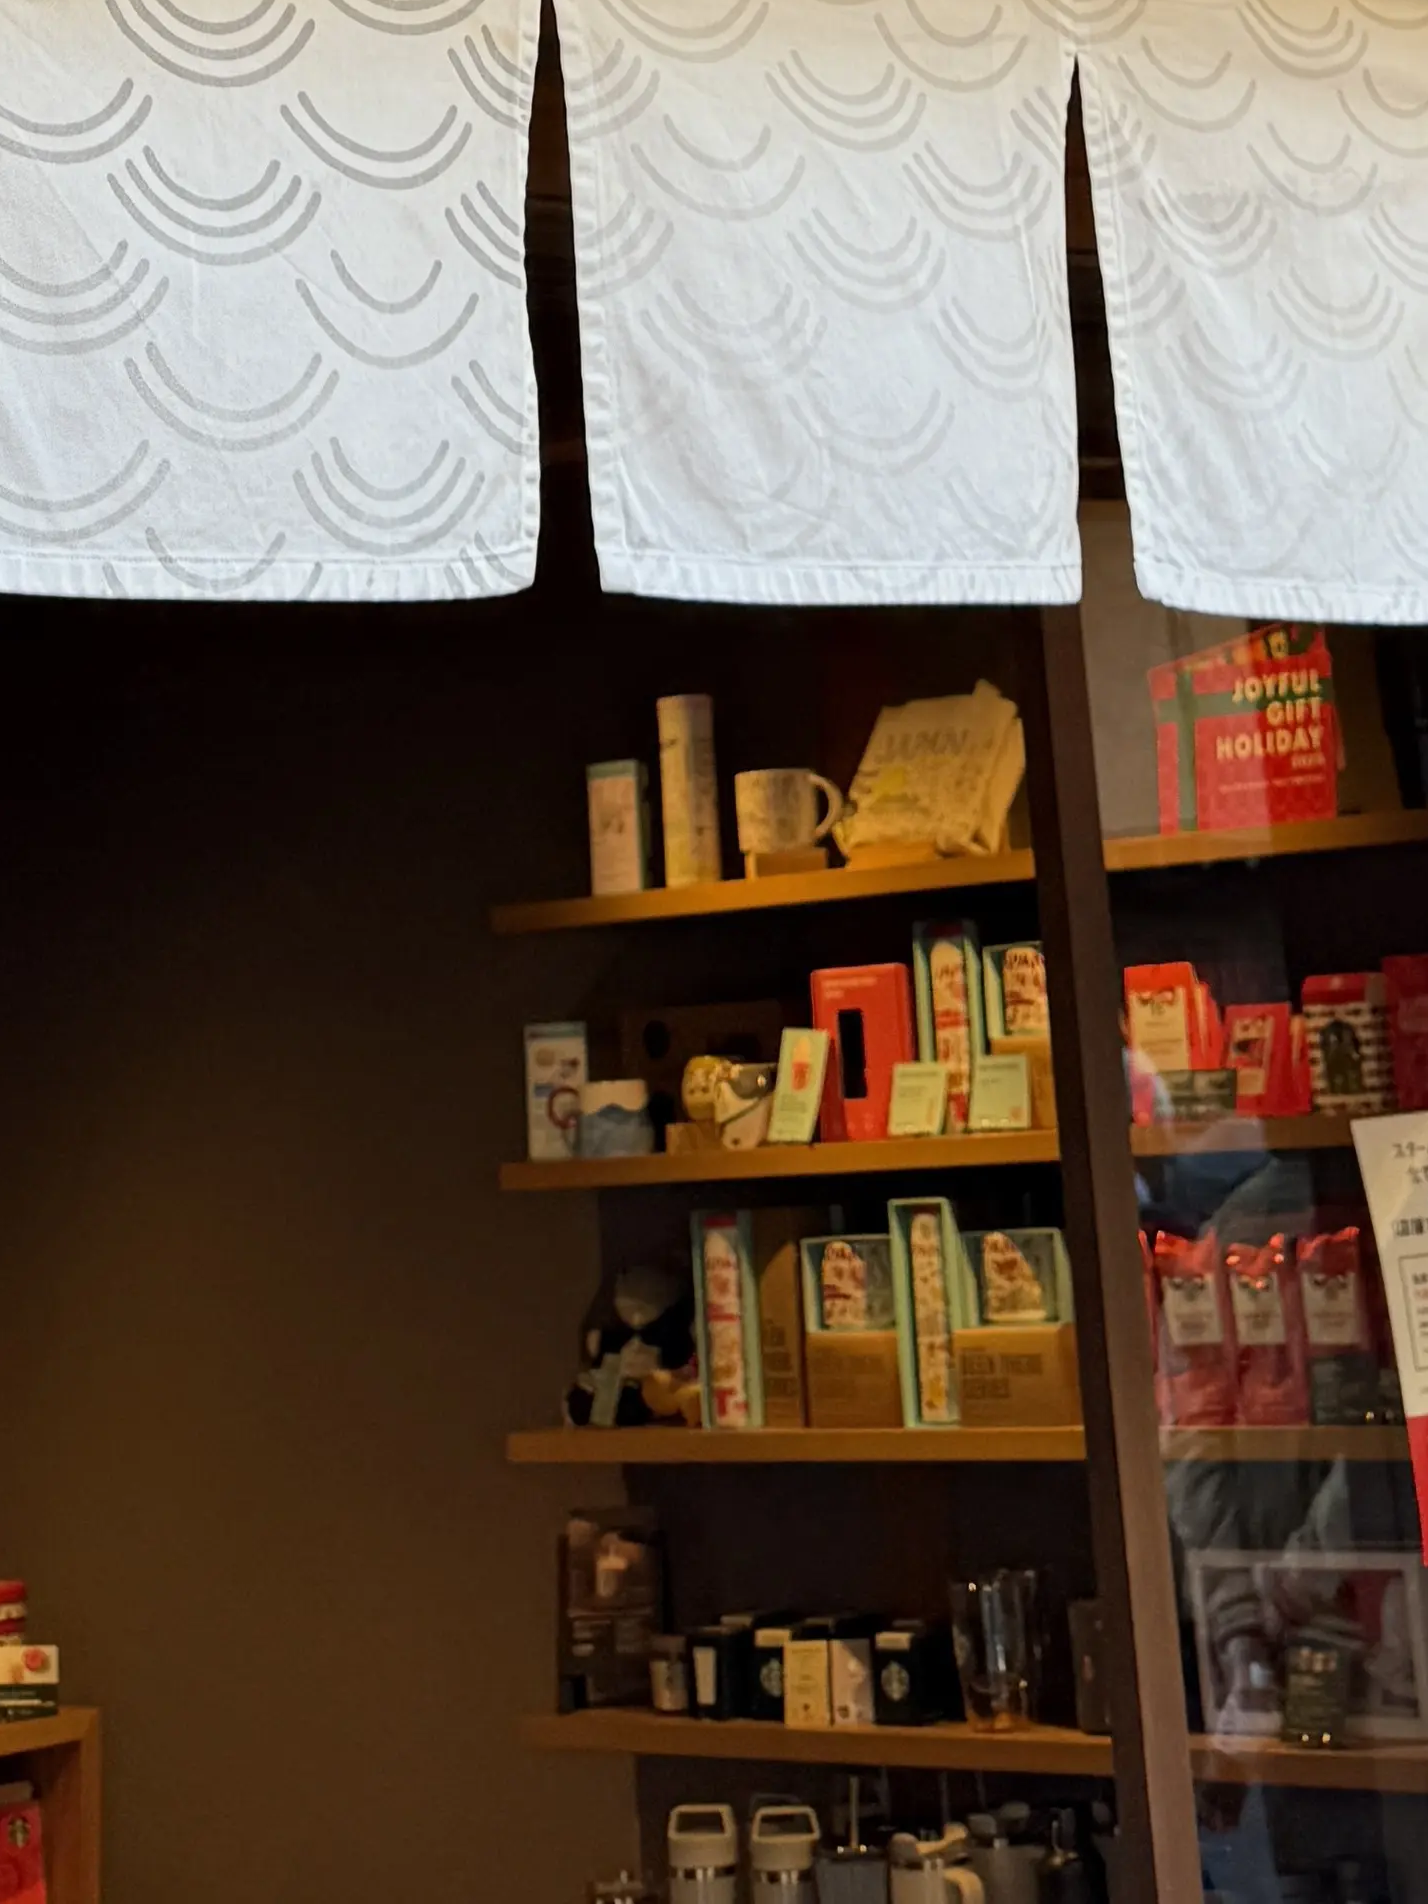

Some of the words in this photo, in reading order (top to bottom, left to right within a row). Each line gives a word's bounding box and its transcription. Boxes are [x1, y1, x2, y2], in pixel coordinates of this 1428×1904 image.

[1232, 668, 1321, 704] JOYFUL
[1266, 696, 1322, 726] GIFT
[1215, 725, 1324, 762] HOLIDAY
